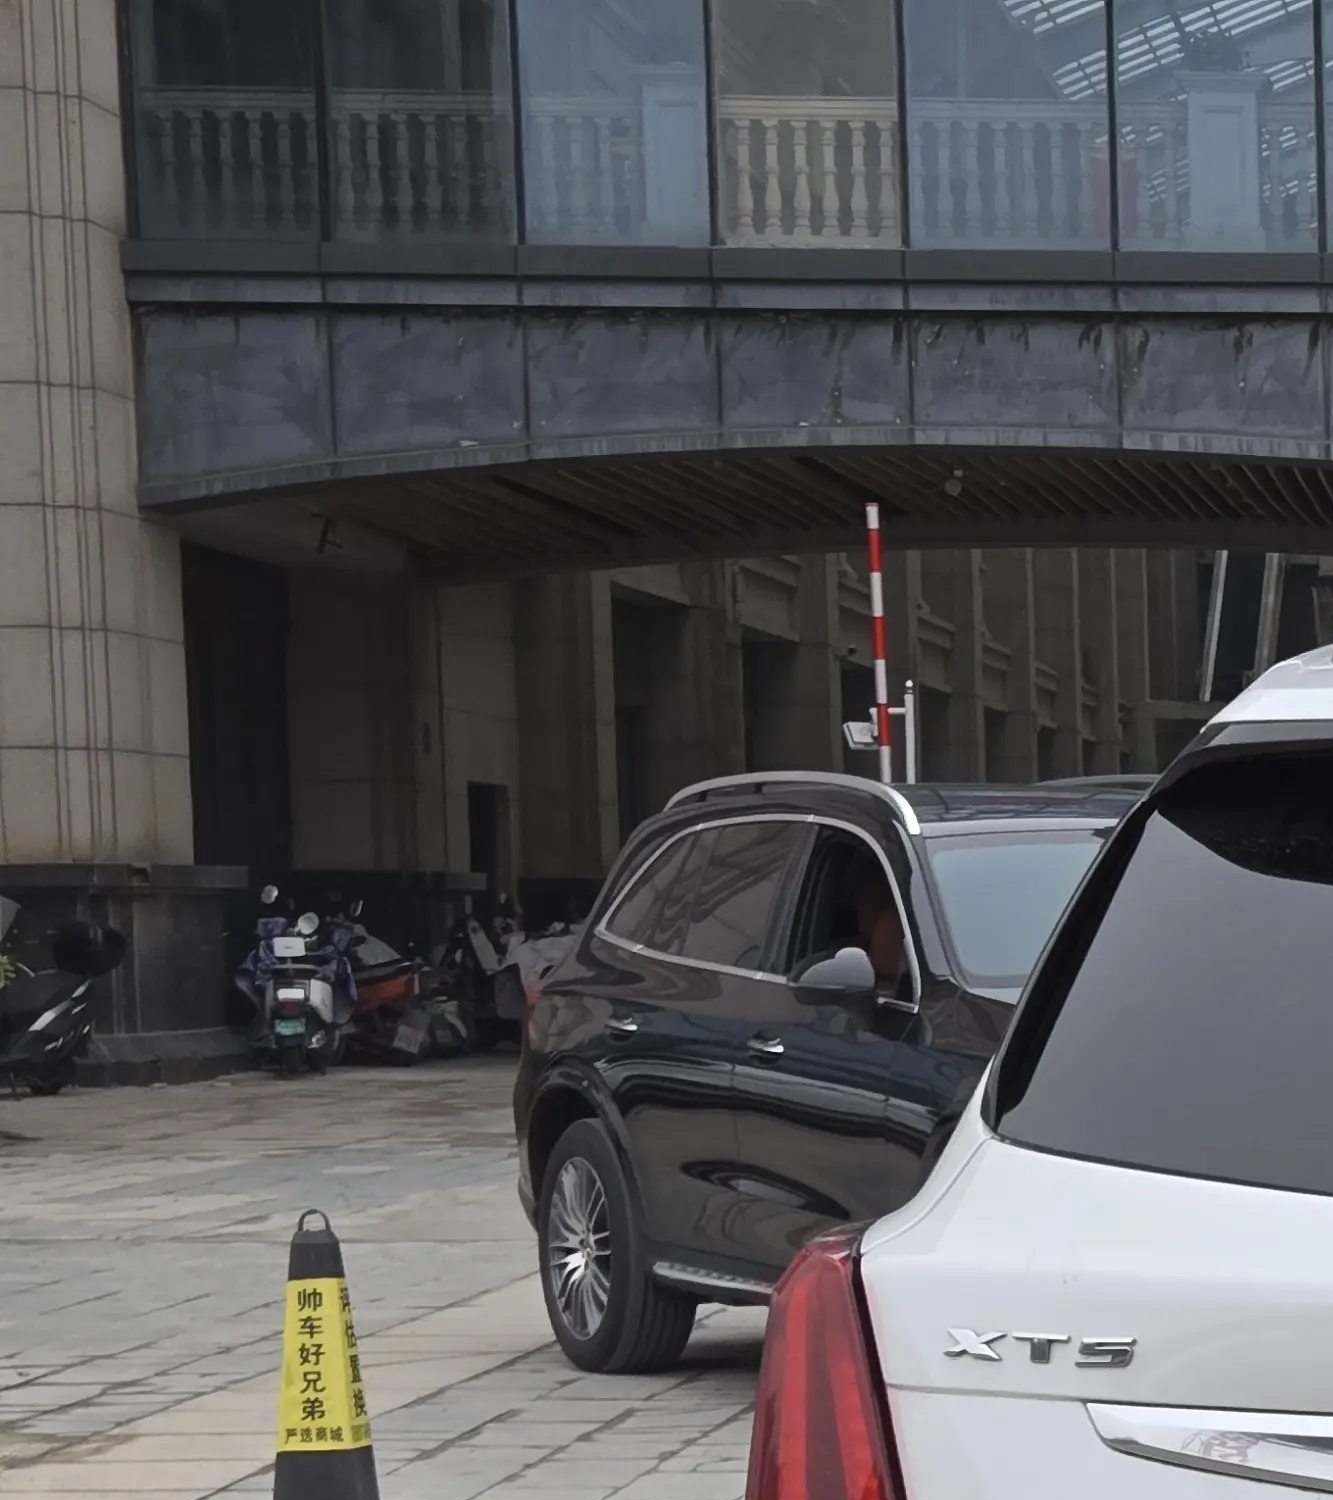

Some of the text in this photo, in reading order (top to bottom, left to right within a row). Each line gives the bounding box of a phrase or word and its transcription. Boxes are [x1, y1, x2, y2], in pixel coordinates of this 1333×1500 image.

[297, 1287, 326, 1421] 帅车好兄弟
[942, 1326, 1138, 1369] XT5
[284, 1425, 344, 1444] 严选商城
